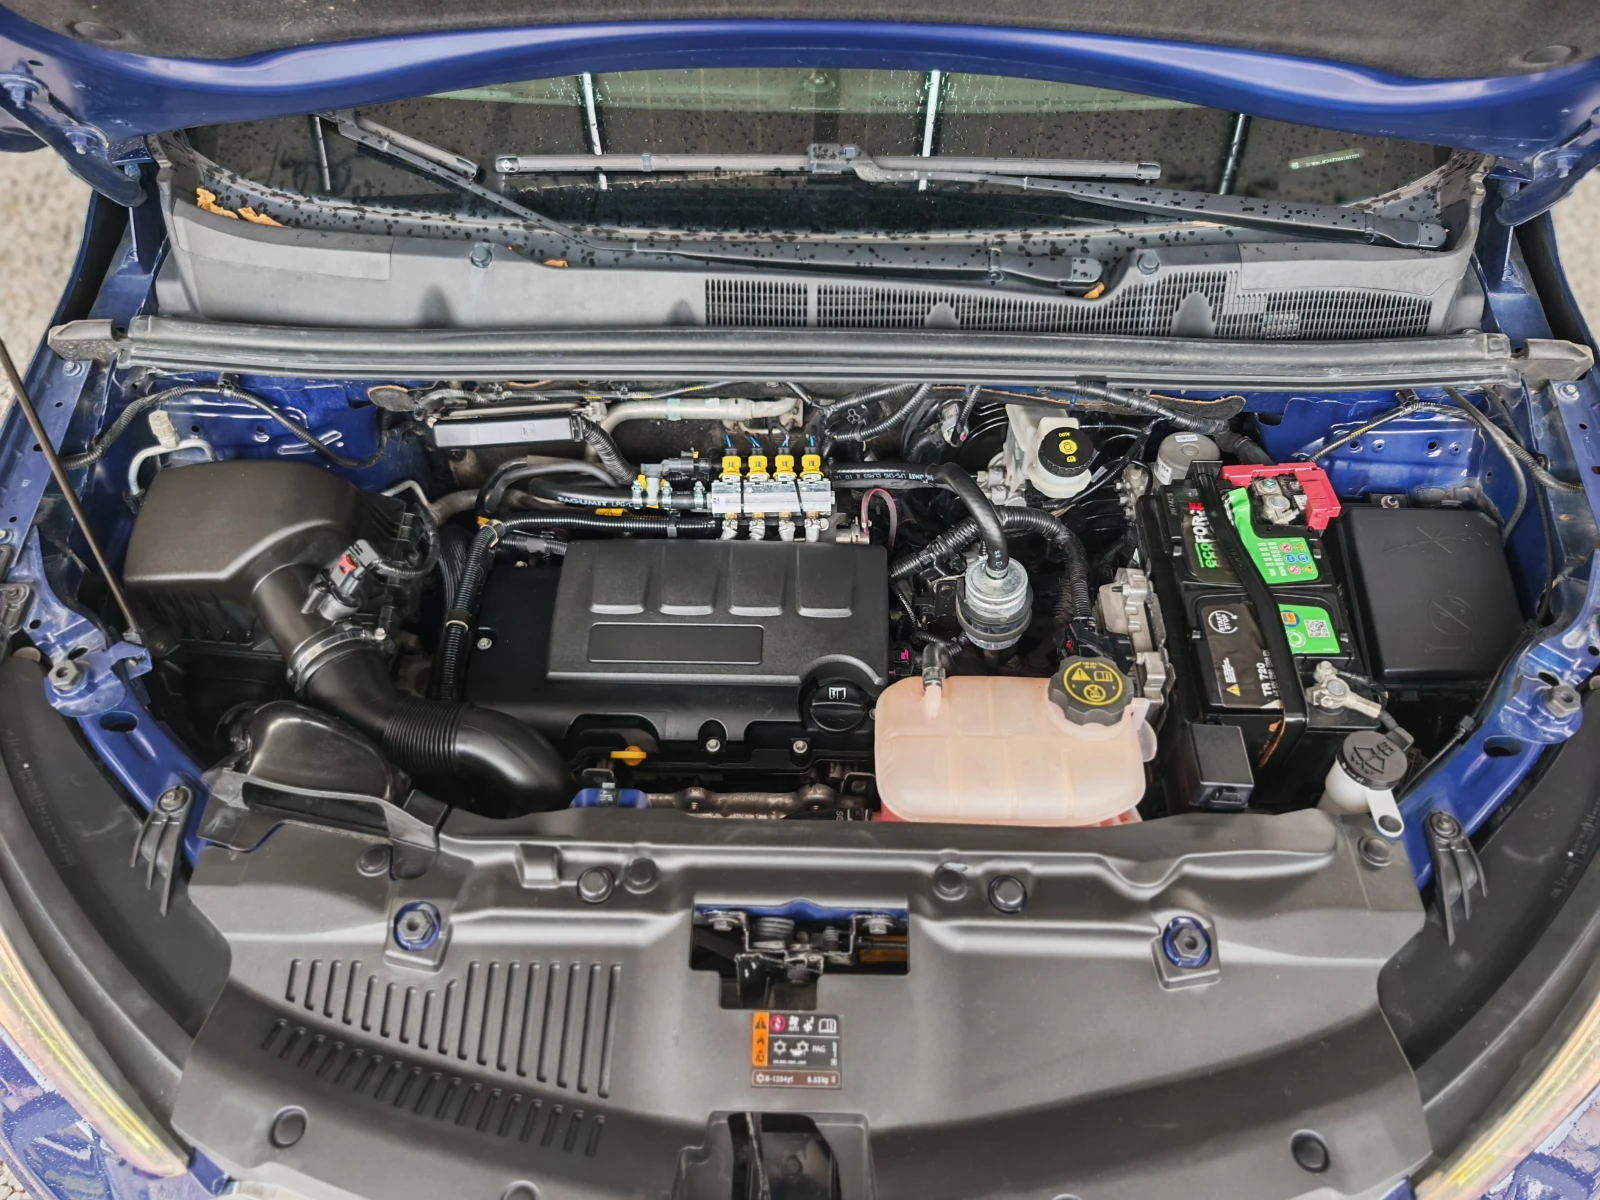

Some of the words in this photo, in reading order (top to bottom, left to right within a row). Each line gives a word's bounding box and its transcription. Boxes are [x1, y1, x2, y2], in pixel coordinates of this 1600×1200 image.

[1215, 612, 1225, 632] START
[1256, 662, 1268, 680] 720
[1261, 682, 1273, 697] TR
[812, 1045, 826, 1053] PAG
